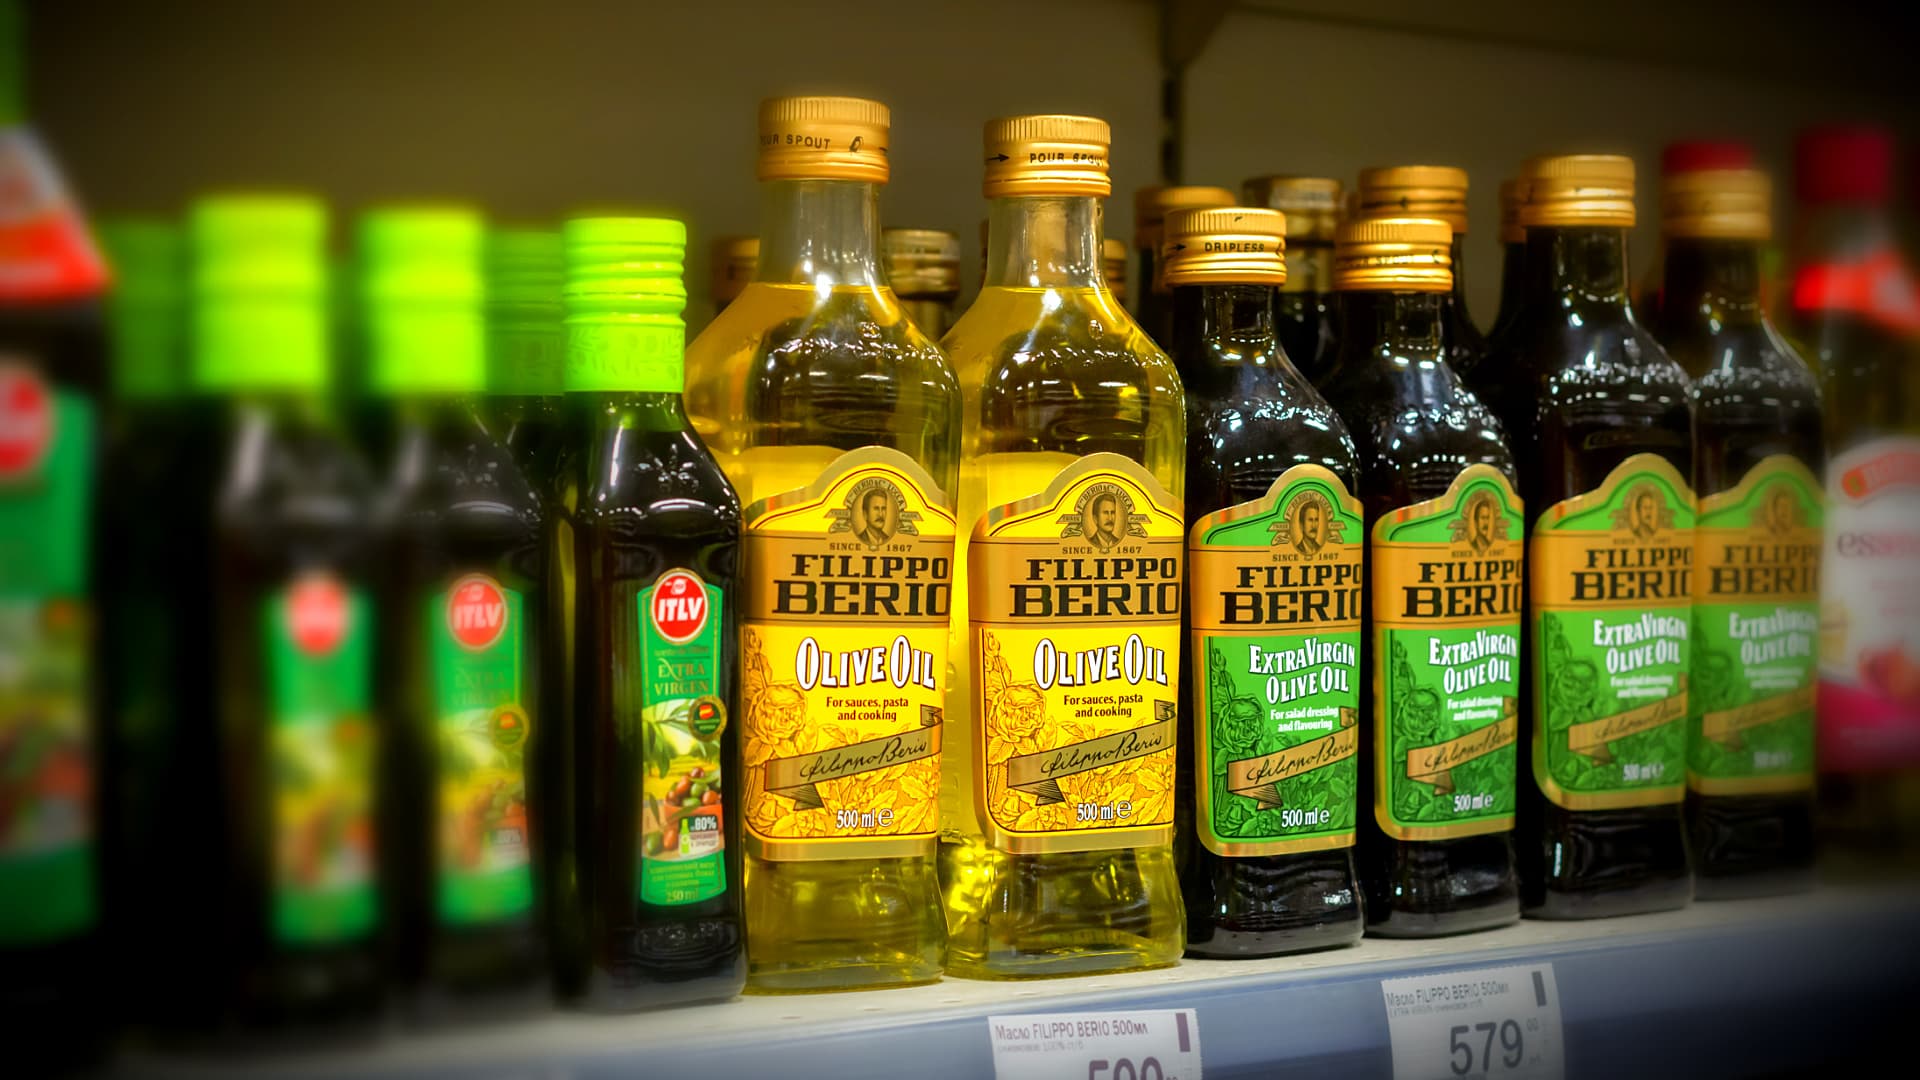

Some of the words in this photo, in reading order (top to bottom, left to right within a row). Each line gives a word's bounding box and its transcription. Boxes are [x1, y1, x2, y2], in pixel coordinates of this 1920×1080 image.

[786, 133, 831, 150] SPOUT
[1030, 152, 1065, 163] POUR
[1204, 242, 1265, 253] DRIPLESS
[829, 542, 861, 551] SINCE
[1062, 546, 1093, 554] SINCE
[1116, 546, 1142, 554] 1867
[791, 553, 948, 580] FILIPPO
[1272, 554, 1298, 562] SINCE
[1026, 557, 1177, 581] FILIPPO
[772, 580, 951, 617] BERIO
[1009, 582, 1180, 617] BERIO
[454, 602, 501, 630] ITLV
[657, 597, 704, 622] ITLV
[795, 636, 887, 691] OLIVE
[890, 634, 936, 692] OIL
[1033, 637, 1121, 690] OLIVE
[1124, 633, 1168, 687] OIL
[1249, 643, 1307, 674] EXTRA
[1305, 637, 1355, 668] VIRGIN
[1606, 648, 1653, 675] OLIVE
[1655, 639, 1680, 664] OIL
[657, 657, 705, 681] EXTRA
[1443, 667, 1486, 694] OLIVE
[1488, 657, 1511, 684] OIL
[1266, 675, 1318, 705] OLIVE
[1320, 666, 1349, 693] OIL
[826, 696, 844, 707] For
[845, 697, 881, 708] sauces,
[883, 698, 909, 710] pasta
[1063, 695, 1080, 706] For
[1081, 695, 1117, 705] sauces,
[1118, 694, 1143, 706] pasta
[837, 710, 856, 721] and
[858, 711, 897, 722] cooking
[1075, 707, 1093, 717] and
[1094, 707, 1132, 719] cooking
[1270, 709, 1284, 720] For
[1285, 707, 1306, 719] salad
[1278, 720, 1293, 732] and
[1077, 802, 1098, 822] 500
[1100, 801, 1114, 820] ml
[1453, 794, 1471, 812] 500
[694, 816, 717, 831] 80%
[836, 809, 859, 829] 500
[861, 808, 875, 828] ml
[1281, 809, 1303, 828] 500
[1305, 807, 1318, 825] ml
[1416, 985, 1451, 1003] FILIPPO
[1452, 983, 1480, 1000] BERIO
[995, 1024, 1030, 1041] Масло
[1032, 1022, 1074, 1039] FILIPPO
[1078, 1020, 1110, 1037] BERIO
[1113, 1019, 1149, 1036] 500мл
[1450, 1019, 1524, 1076] 579
